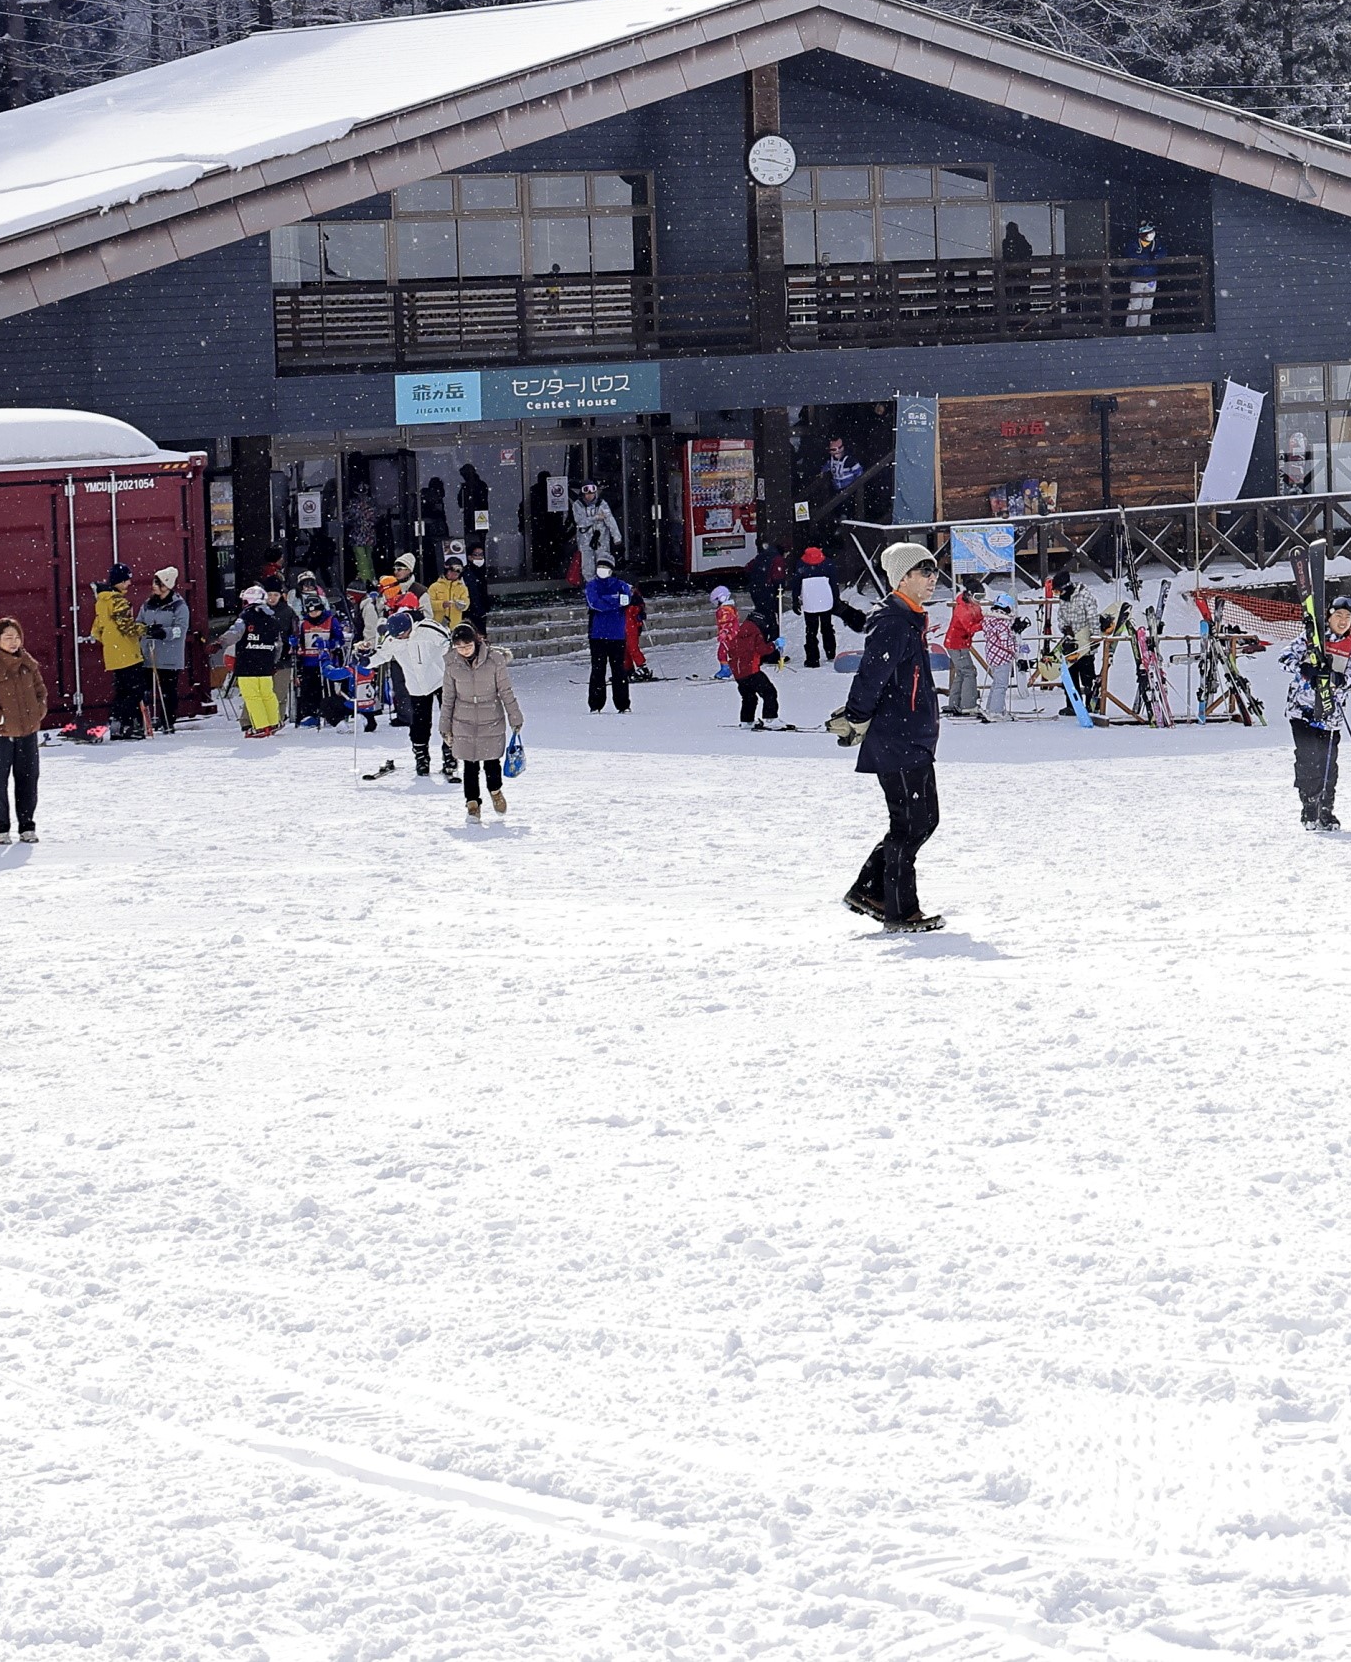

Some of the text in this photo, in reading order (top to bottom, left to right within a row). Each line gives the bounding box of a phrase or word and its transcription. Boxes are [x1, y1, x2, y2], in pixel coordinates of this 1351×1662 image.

[511, 375, 631, 396] センターハウス
[577, 396, 617, 408] House
[415, 405, 462, 414] JIIGATAKE
[84, 478, 155, 493] YMCU 2021054
[246, 632, 260, 641] Ski
[245, 642, 275, 651] Academy
[1320, 689, 1330, 699] V2
